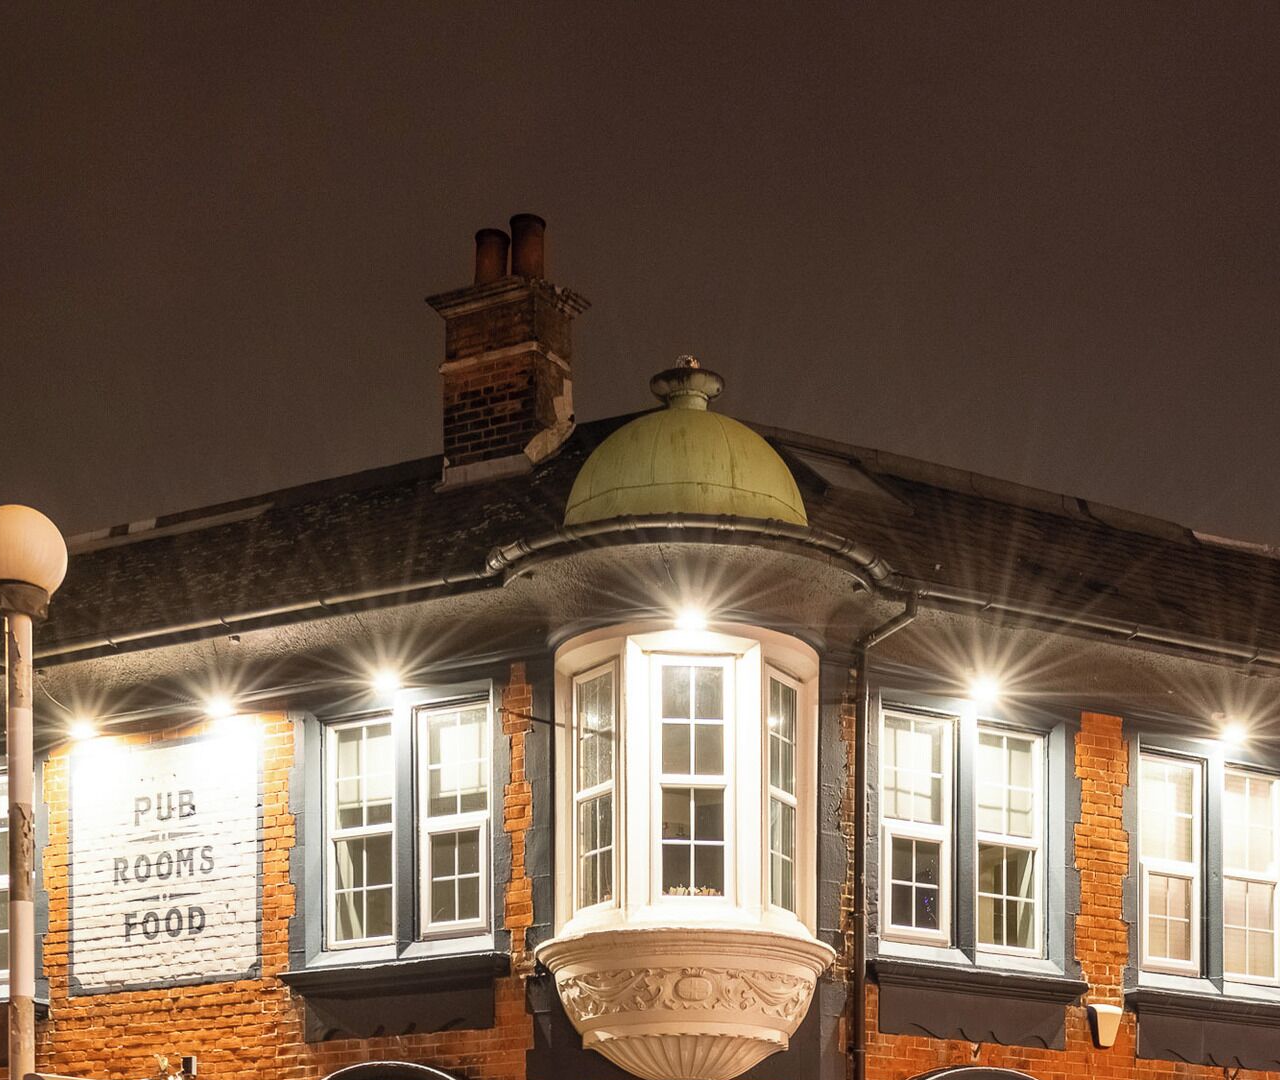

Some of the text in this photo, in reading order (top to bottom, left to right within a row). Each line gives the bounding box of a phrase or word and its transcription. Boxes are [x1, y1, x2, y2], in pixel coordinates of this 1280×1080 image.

[134, 790, 196, 826] PUB
[113, 845, 215, 886] ROOMS
[124, 906, 206, 942] FOOD
